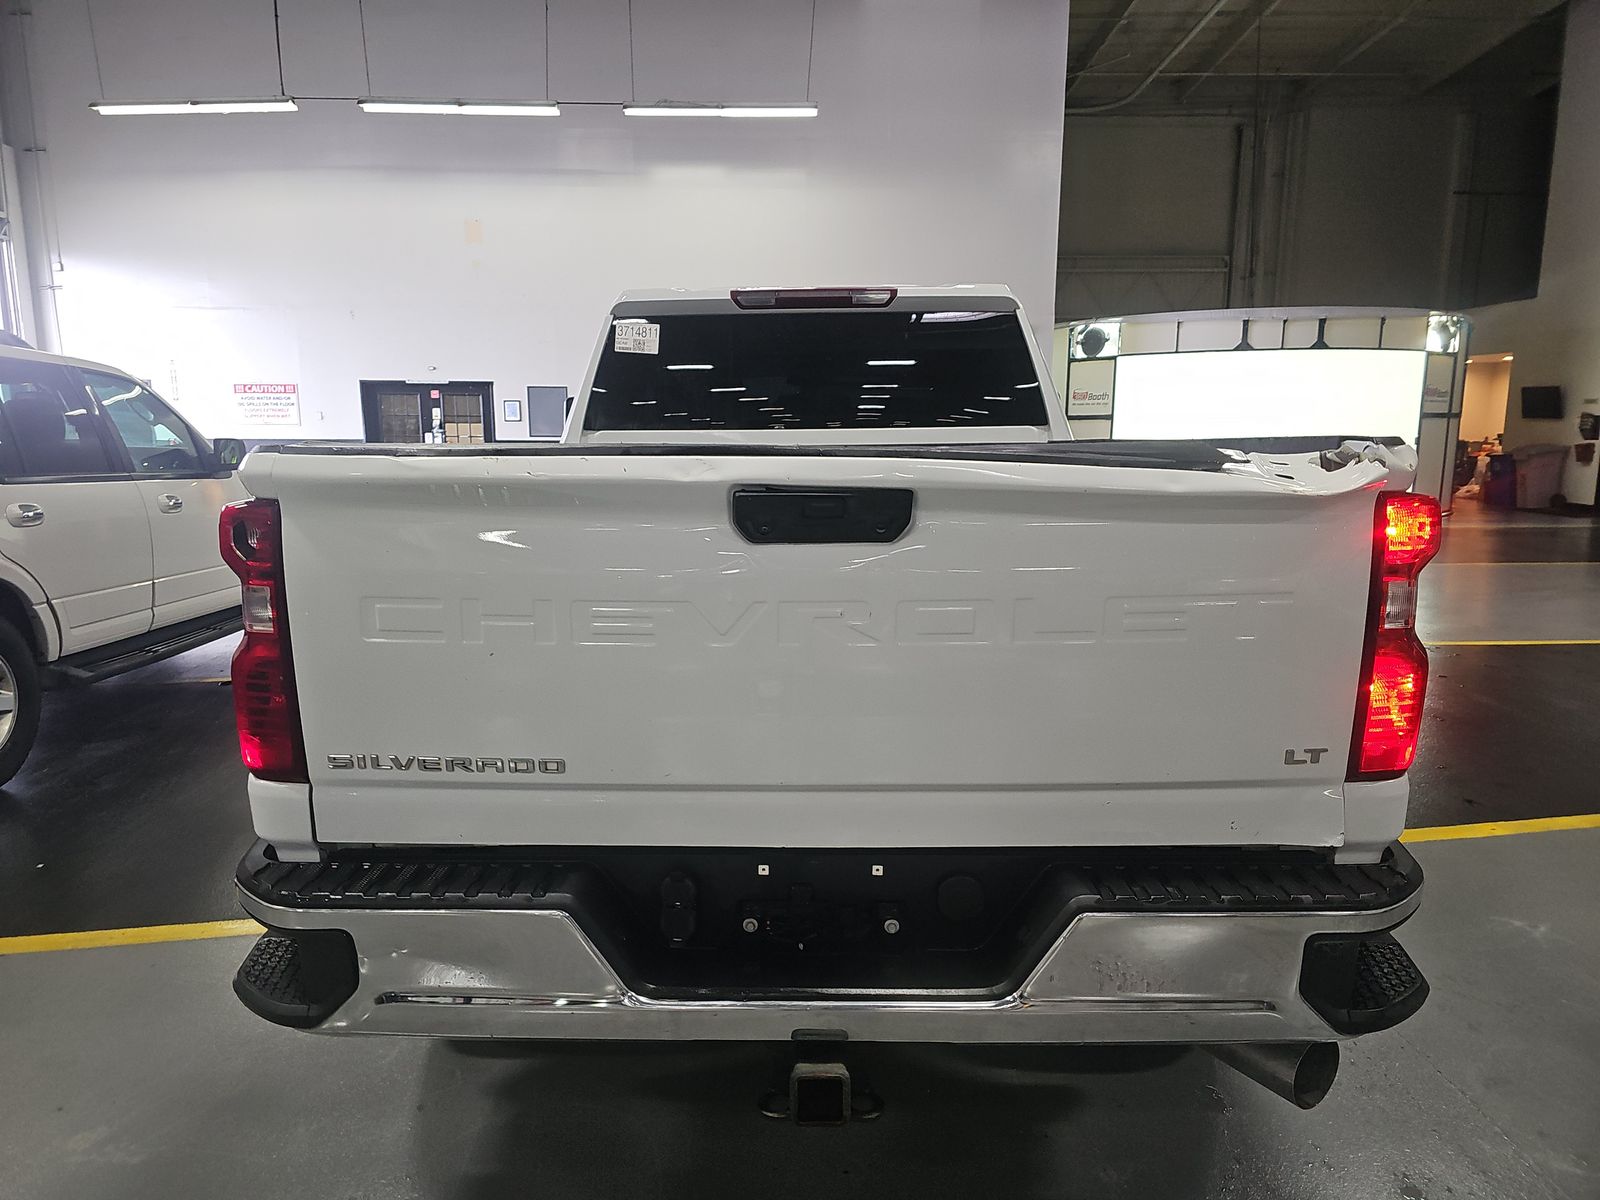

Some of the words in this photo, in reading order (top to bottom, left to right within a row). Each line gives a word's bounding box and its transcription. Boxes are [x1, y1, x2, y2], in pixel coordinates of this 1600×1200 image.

[617, 325, 658, 338] 3714811
[244, 384, 285, 393] CAUTION
[360, 591, 1295, 647] CHEVROLET
[327, 754, 566, 774] SILVERADO
[1284, 748, 1328, 765] LT
